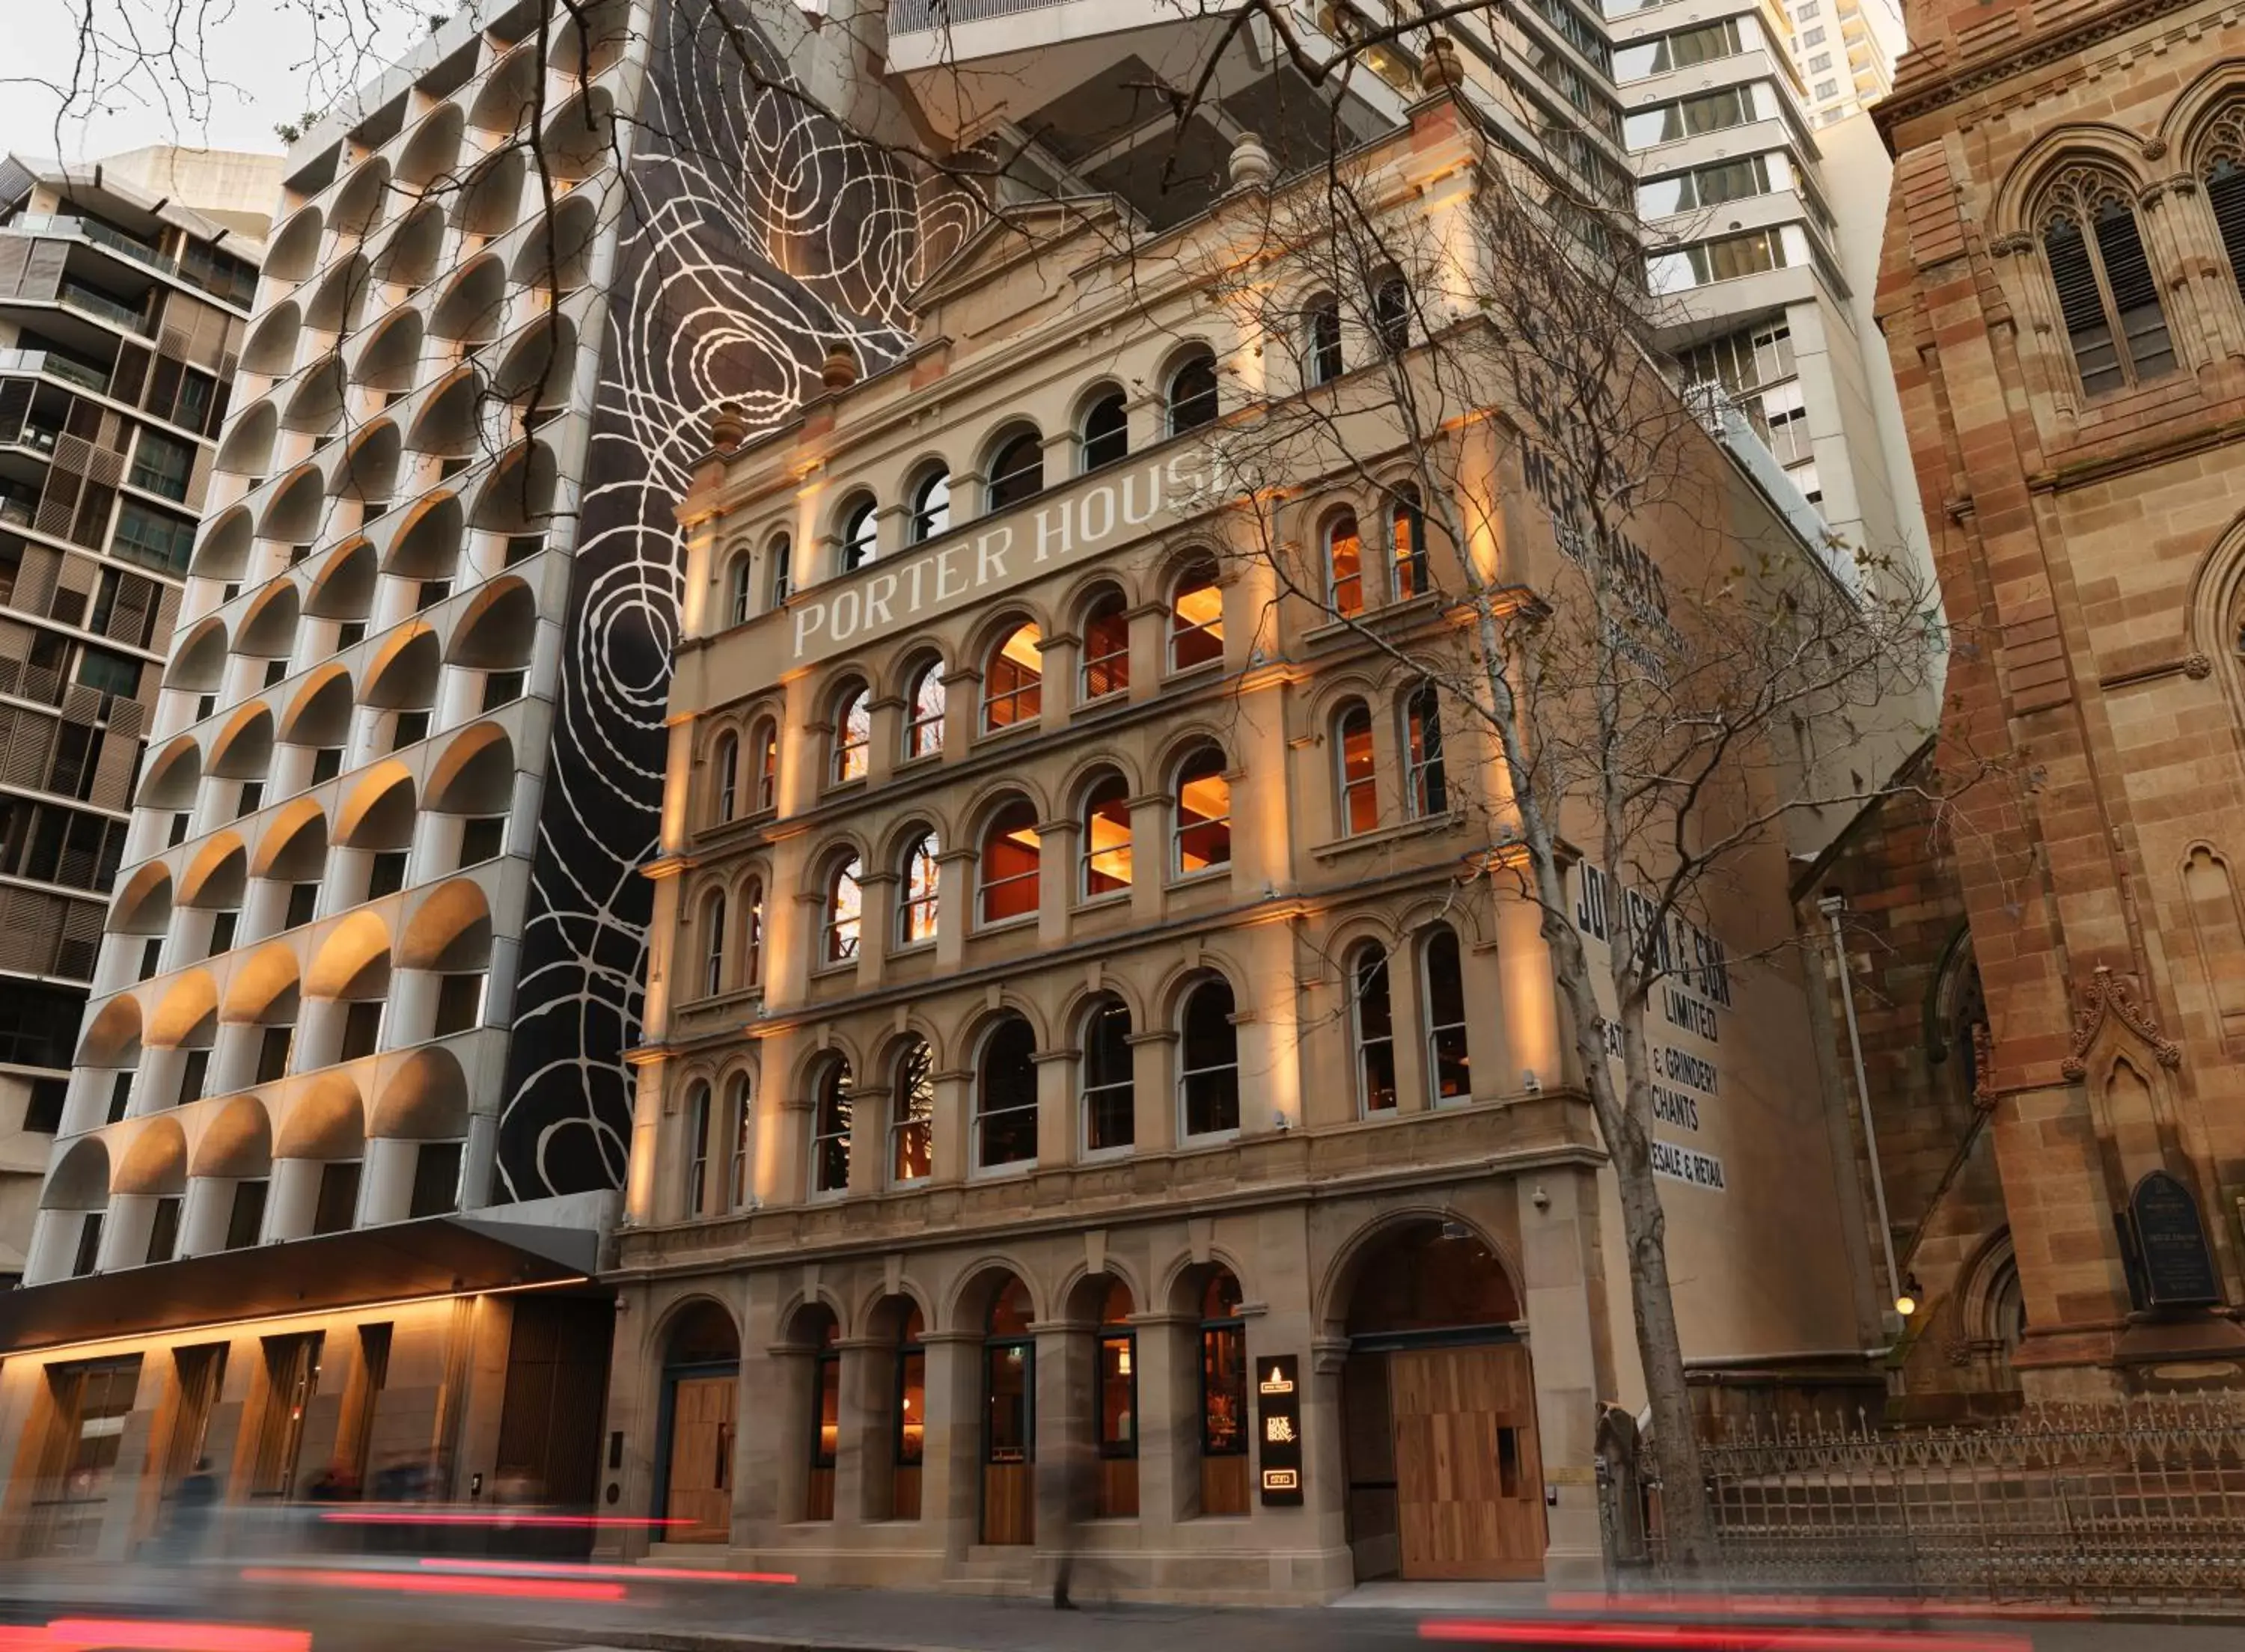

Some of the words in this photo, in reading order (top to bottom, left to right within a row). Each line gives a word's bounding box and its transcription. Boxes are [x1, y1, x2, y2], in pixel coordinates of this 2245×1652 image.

[792, 526, 1013, 658] PORTER
[1033, 432, 1252, 563] HOUSE
[1663, 985, 1718, 1042] LIMITED
[1665, 1047, 1718, 1095] GRINDERY
[1652, 1084, 1698, 1131] CHANTS
[1652, 1142, 1683, 1177] ESALE
[1694, 1155, 1724, 1189] RETAIL
